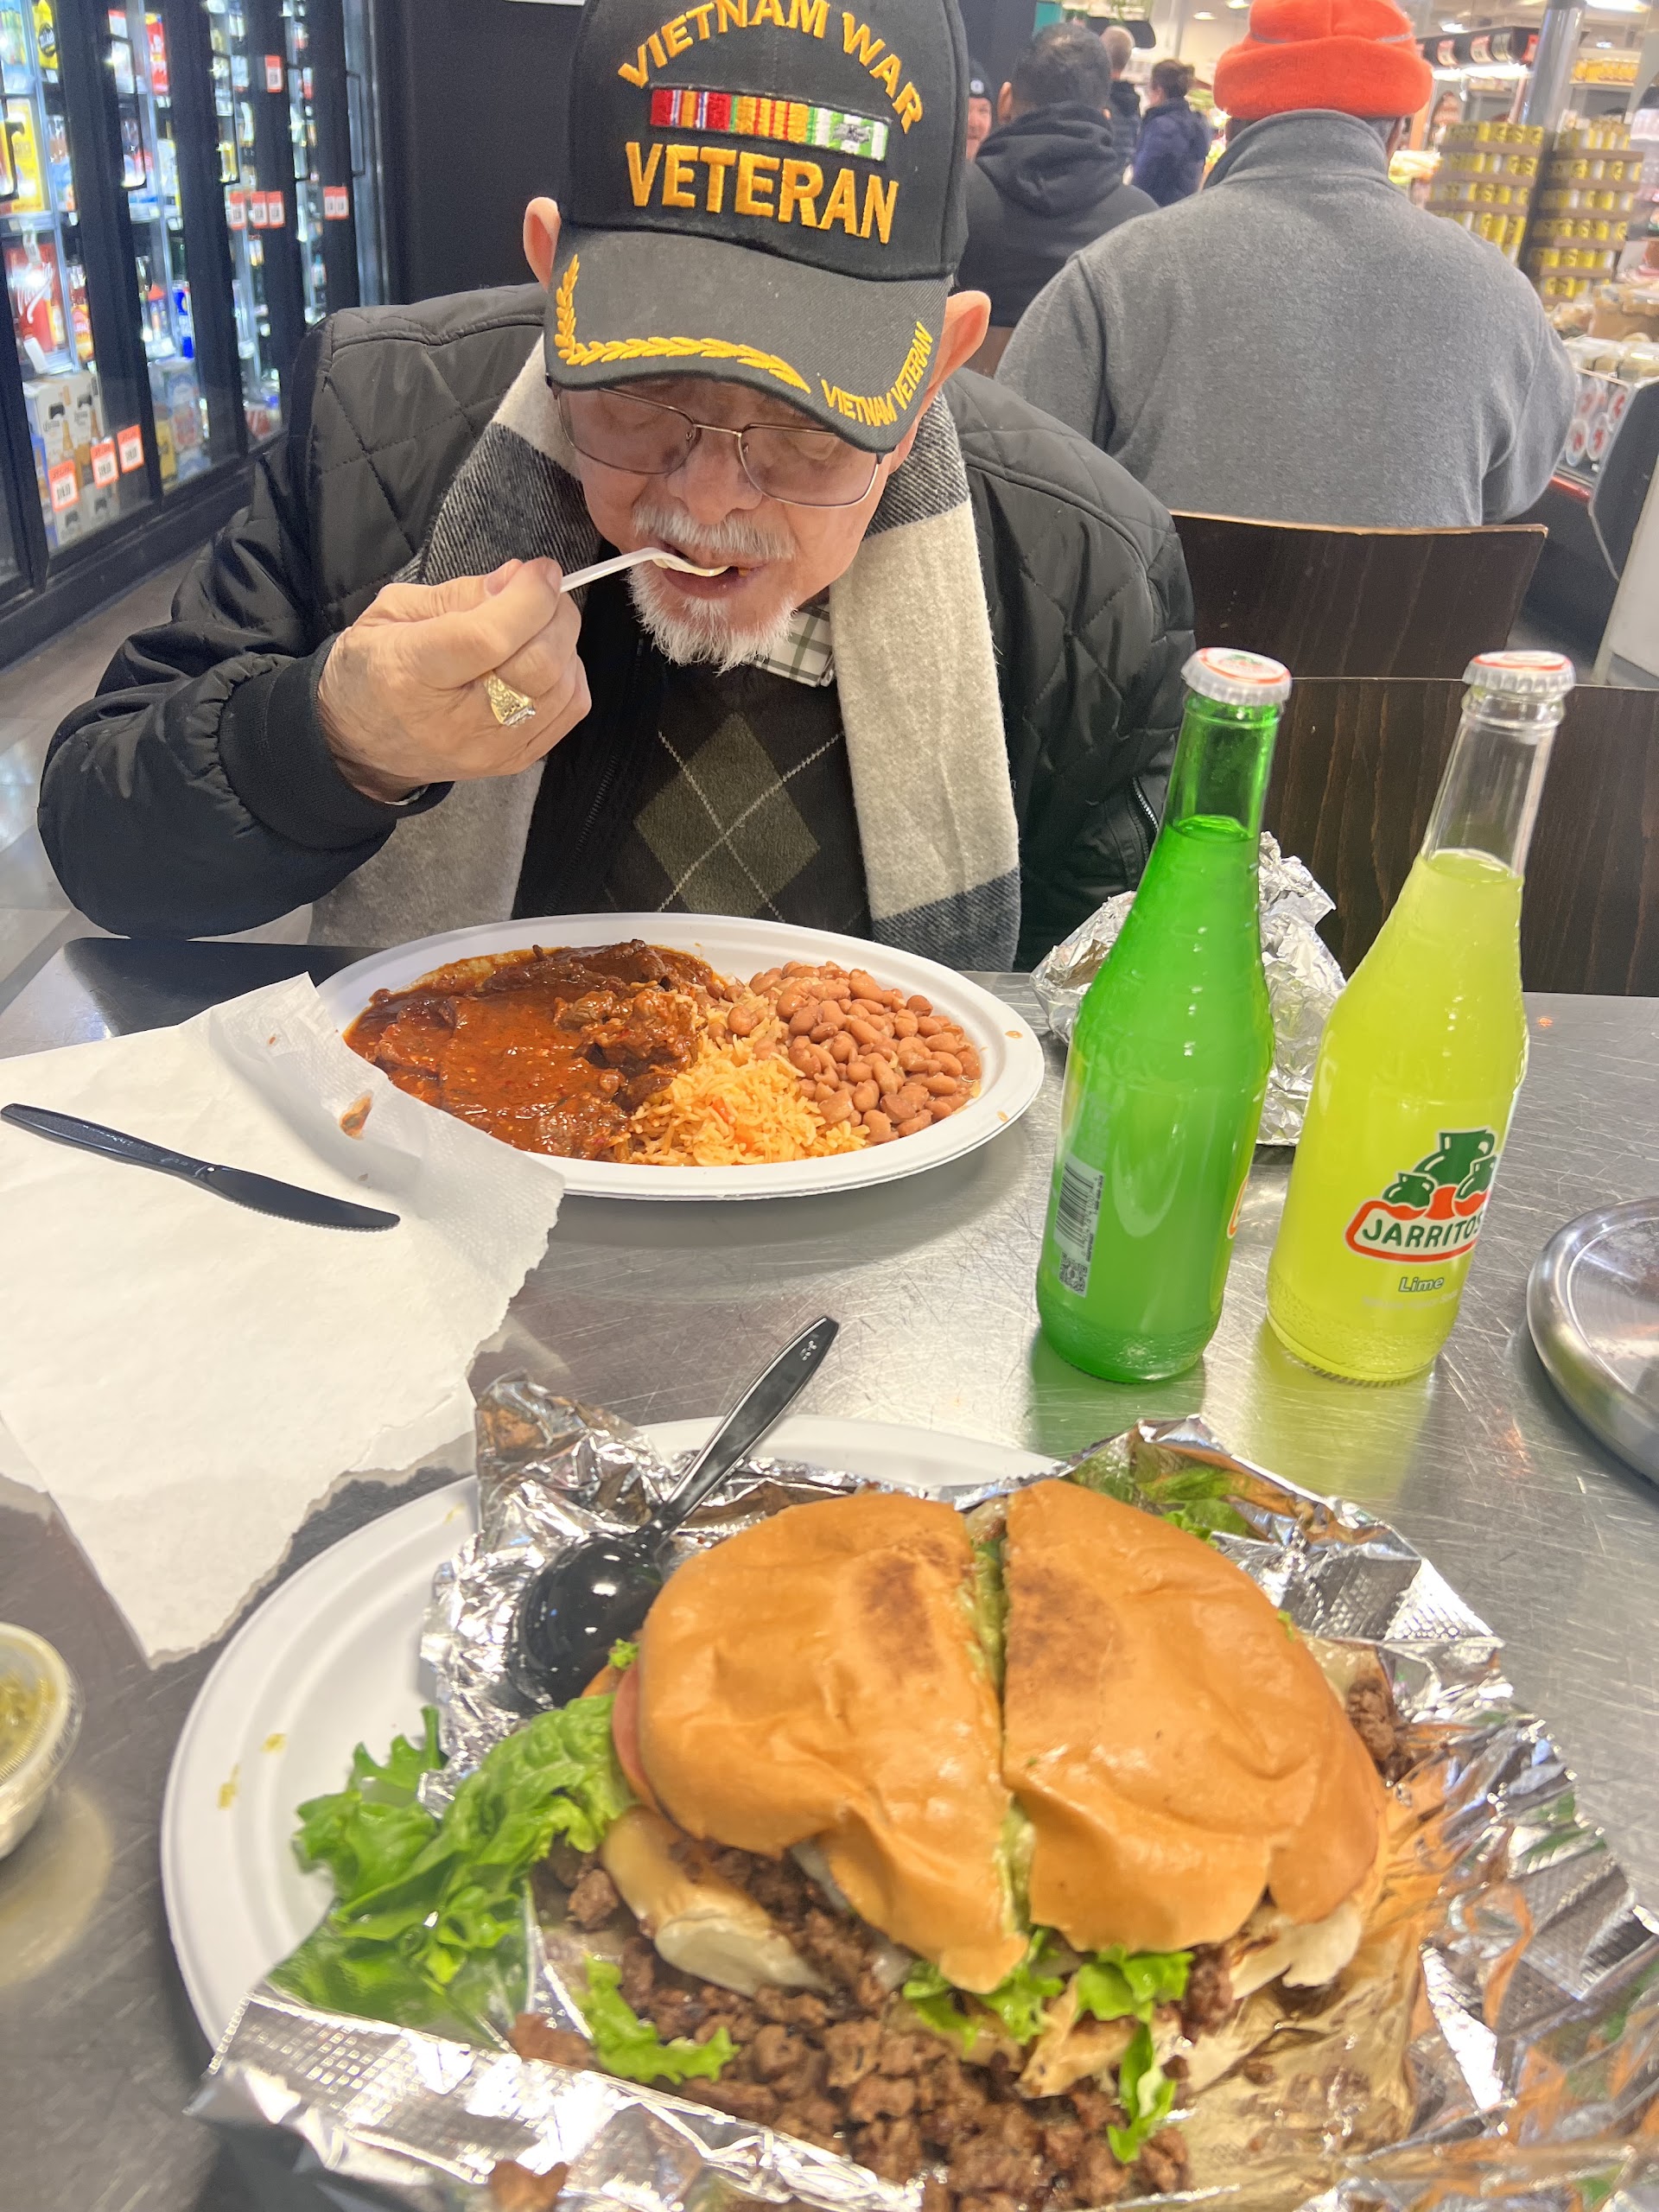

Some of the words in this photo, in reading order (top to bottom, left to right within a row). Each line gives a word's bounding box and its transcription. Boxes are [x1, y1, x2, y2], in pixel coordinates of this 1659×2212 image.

[618, 0, 830, 88] VIETNAM
[842, 11, 924, 135] WAR
[626, 142, 898, 244] VETERAN
[821, 378, 897, 427] VIETNAM
[891, 321, 933, 410] VETERAN
[1398, 1277, 1445, 1292] Lime
